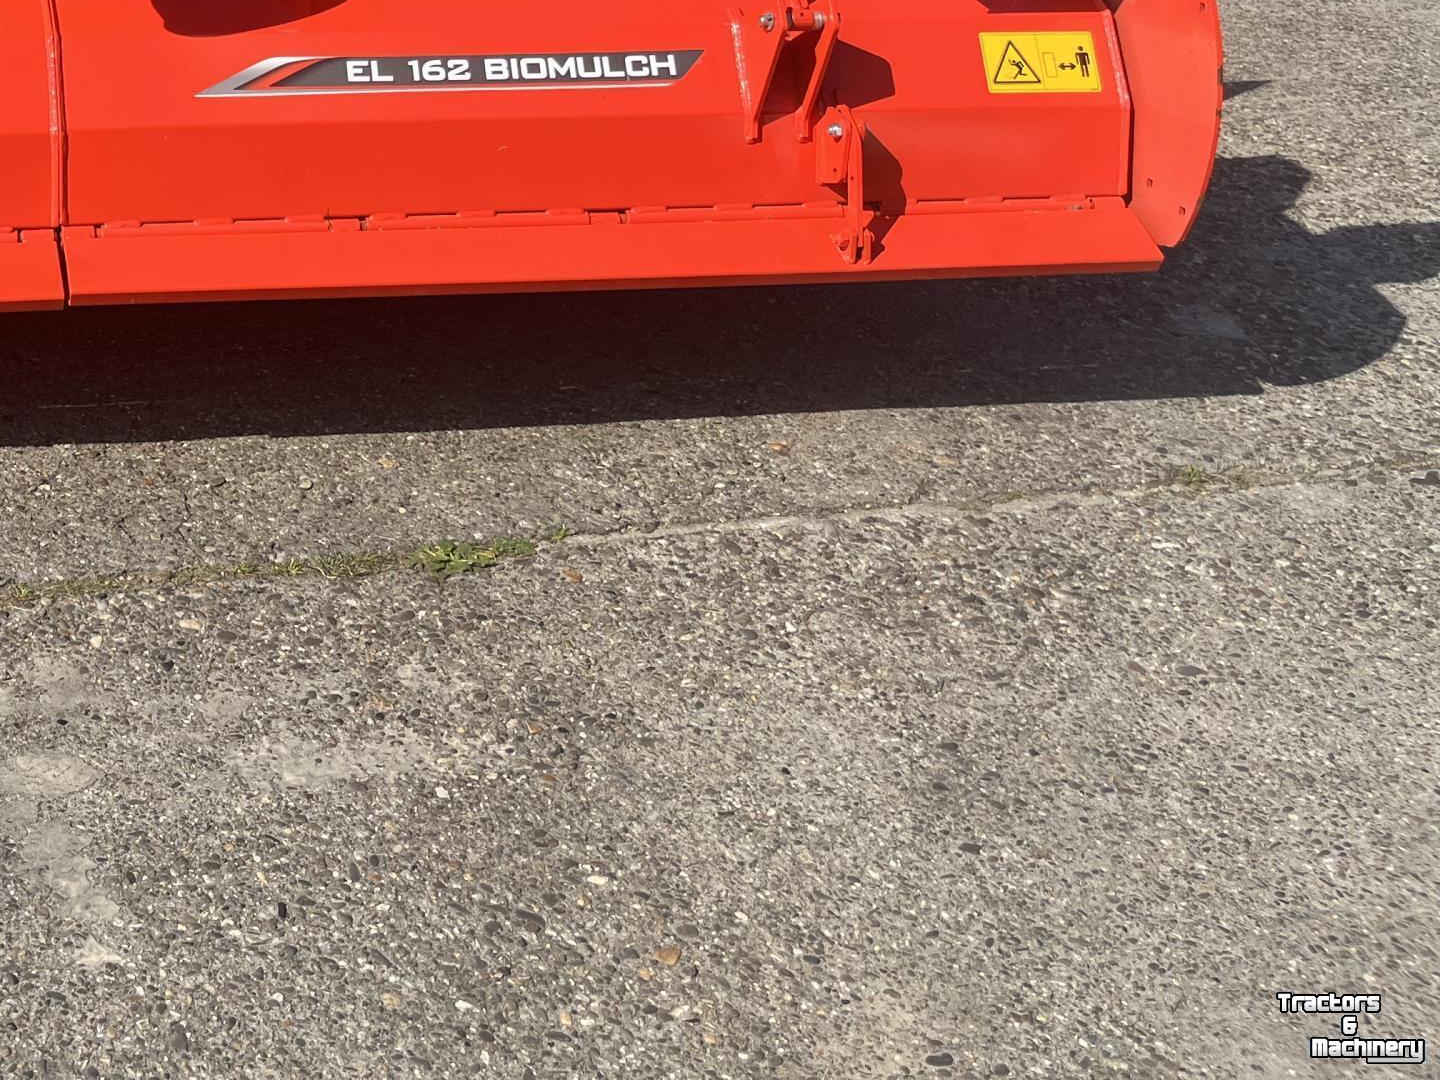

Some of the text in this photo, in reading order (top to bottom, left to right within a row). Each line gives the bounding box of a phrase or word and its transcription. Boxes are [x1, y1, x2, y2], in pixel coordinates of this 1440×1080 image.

[345, 54, 678, 83] EL 162 BIOMULCH
